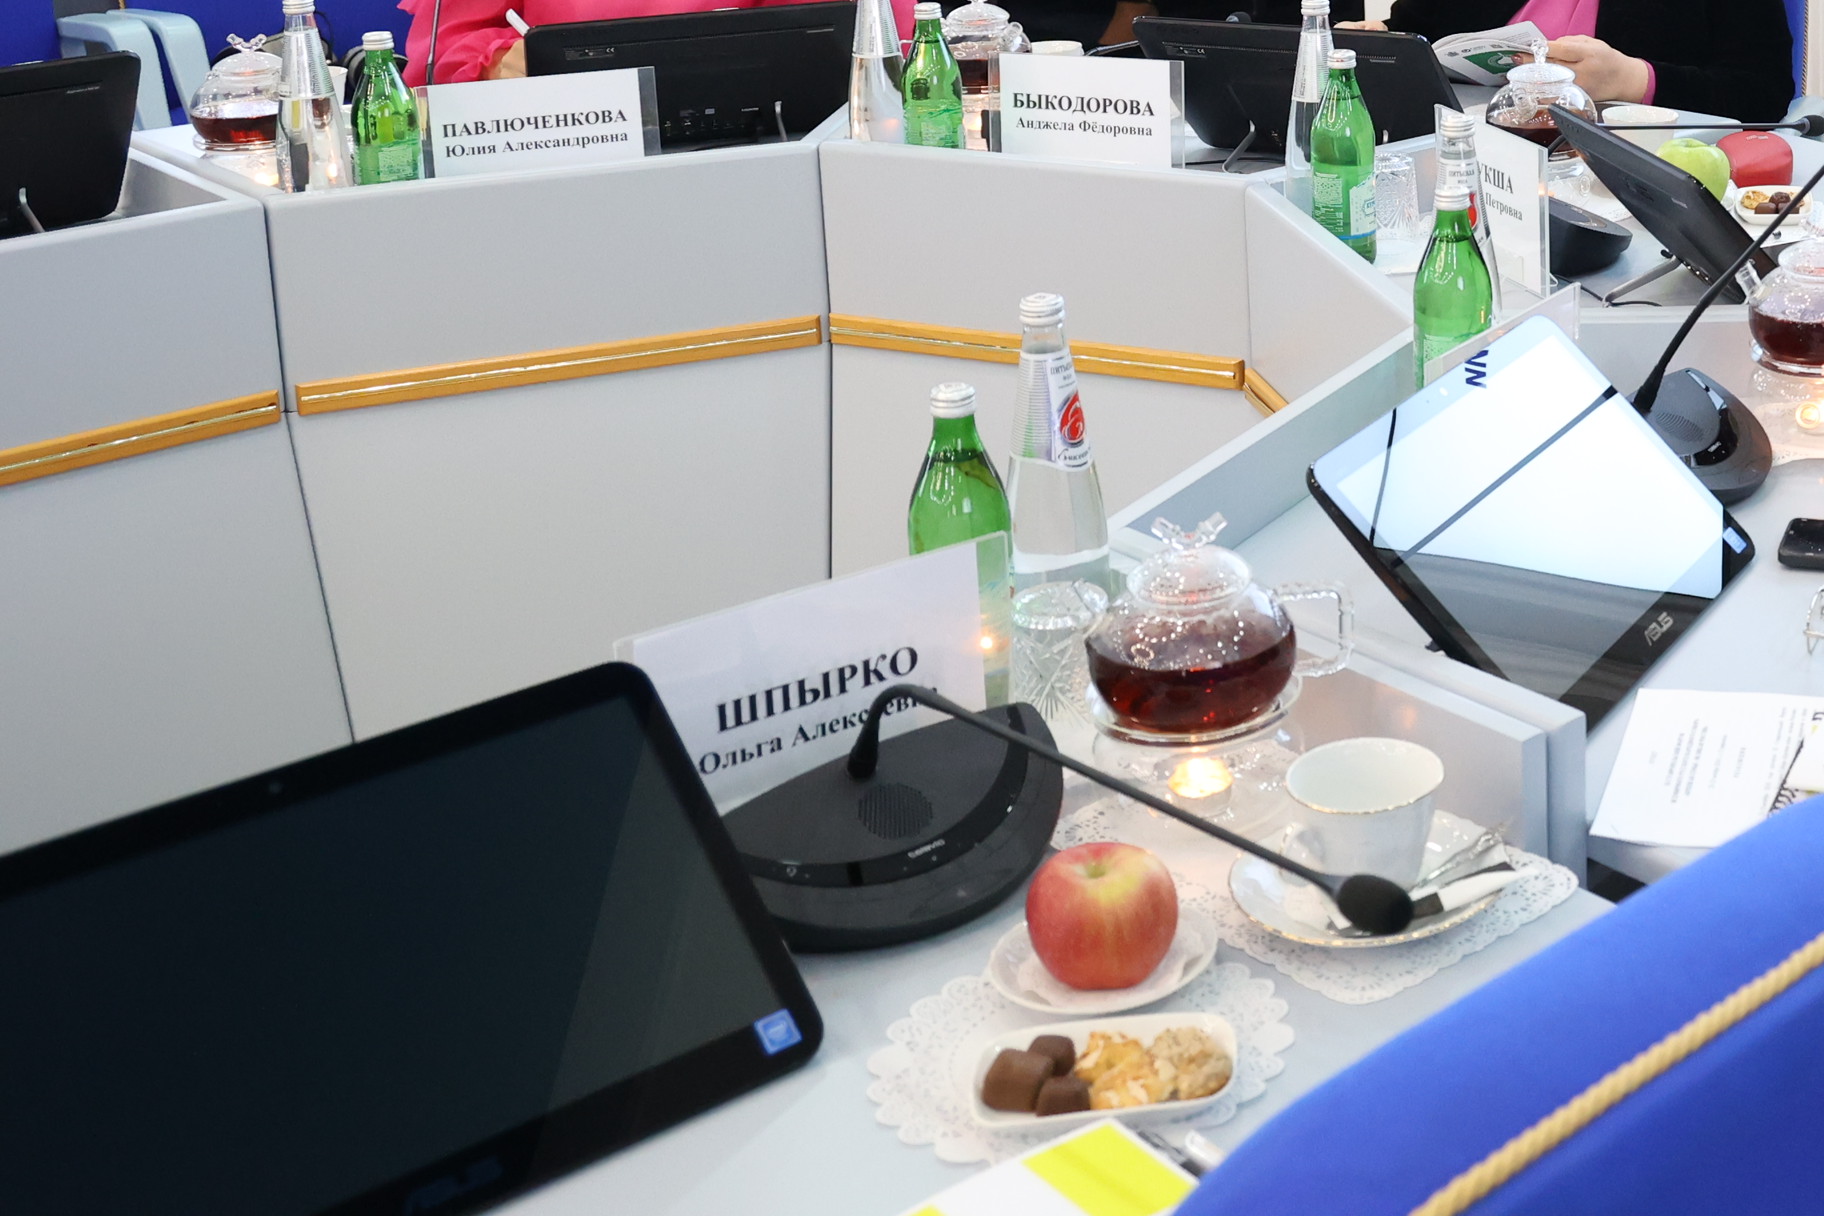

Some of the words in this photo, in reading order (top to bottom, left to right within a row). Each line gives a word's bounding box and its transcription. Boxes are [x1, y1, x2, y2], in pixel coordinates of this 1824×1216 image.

[1013, 92, 1155, 117] БЫКОДОРОВА
[442, 109, 628, 139] ПАВЛЮЧЕНКОВА
[1015, 117, 1075, 132] Анджела
[1079, 120, 1153, 138] Фёдоровна
[445, 144, 497, 159] Юлия
[502, 131, 629, 153] Александровна
[1485, 192, 1523, 222] Петровна
[716, 646, 919, 734] ШПЫРКО
[699, 735, 783, 776] Ольга
